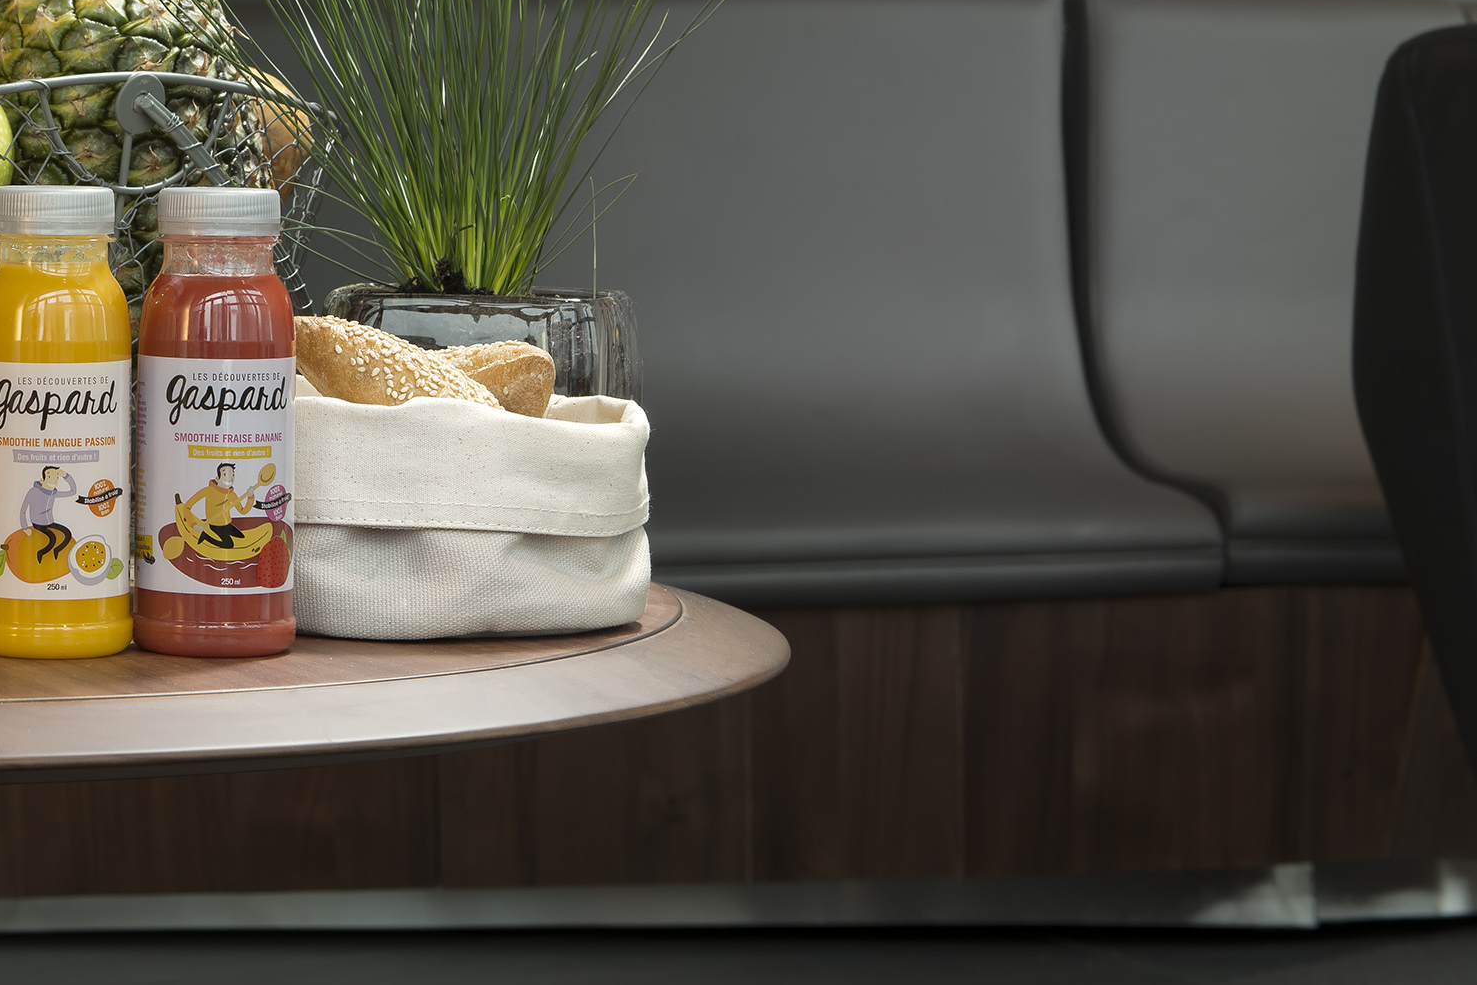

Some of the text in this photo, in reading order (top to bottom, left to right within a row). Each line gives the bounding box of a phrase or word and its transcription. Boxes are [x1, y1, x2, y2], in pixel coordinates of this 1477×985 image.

[17, 375, 109, 386] LES DÉCOUVERTES DE
[192, 371, 281, 382] LES DÉCOUVERTES DE
[166, 374, 288, 427] gaspard
[43, 437, 82, 447] MANGUE
[85, 436, 116, 446] PASSION
[174, 432, 282, 443] SMOOTHIE FRAISE BANANE
[17, 453, 29, 461] Des
[30, 453, 48, 461] fruits
[57, 453, 71, 461] rien
[71, 453, 93, 461] d'autre
[192, 448, 205, 456] Des
[206, 448, 223, 457] fruits
[225, 449, 232, 457] et
[232, 449, 245, 457] rien
[220, 577, 234, 585] 250
[46, 583, 60, 591] 250
